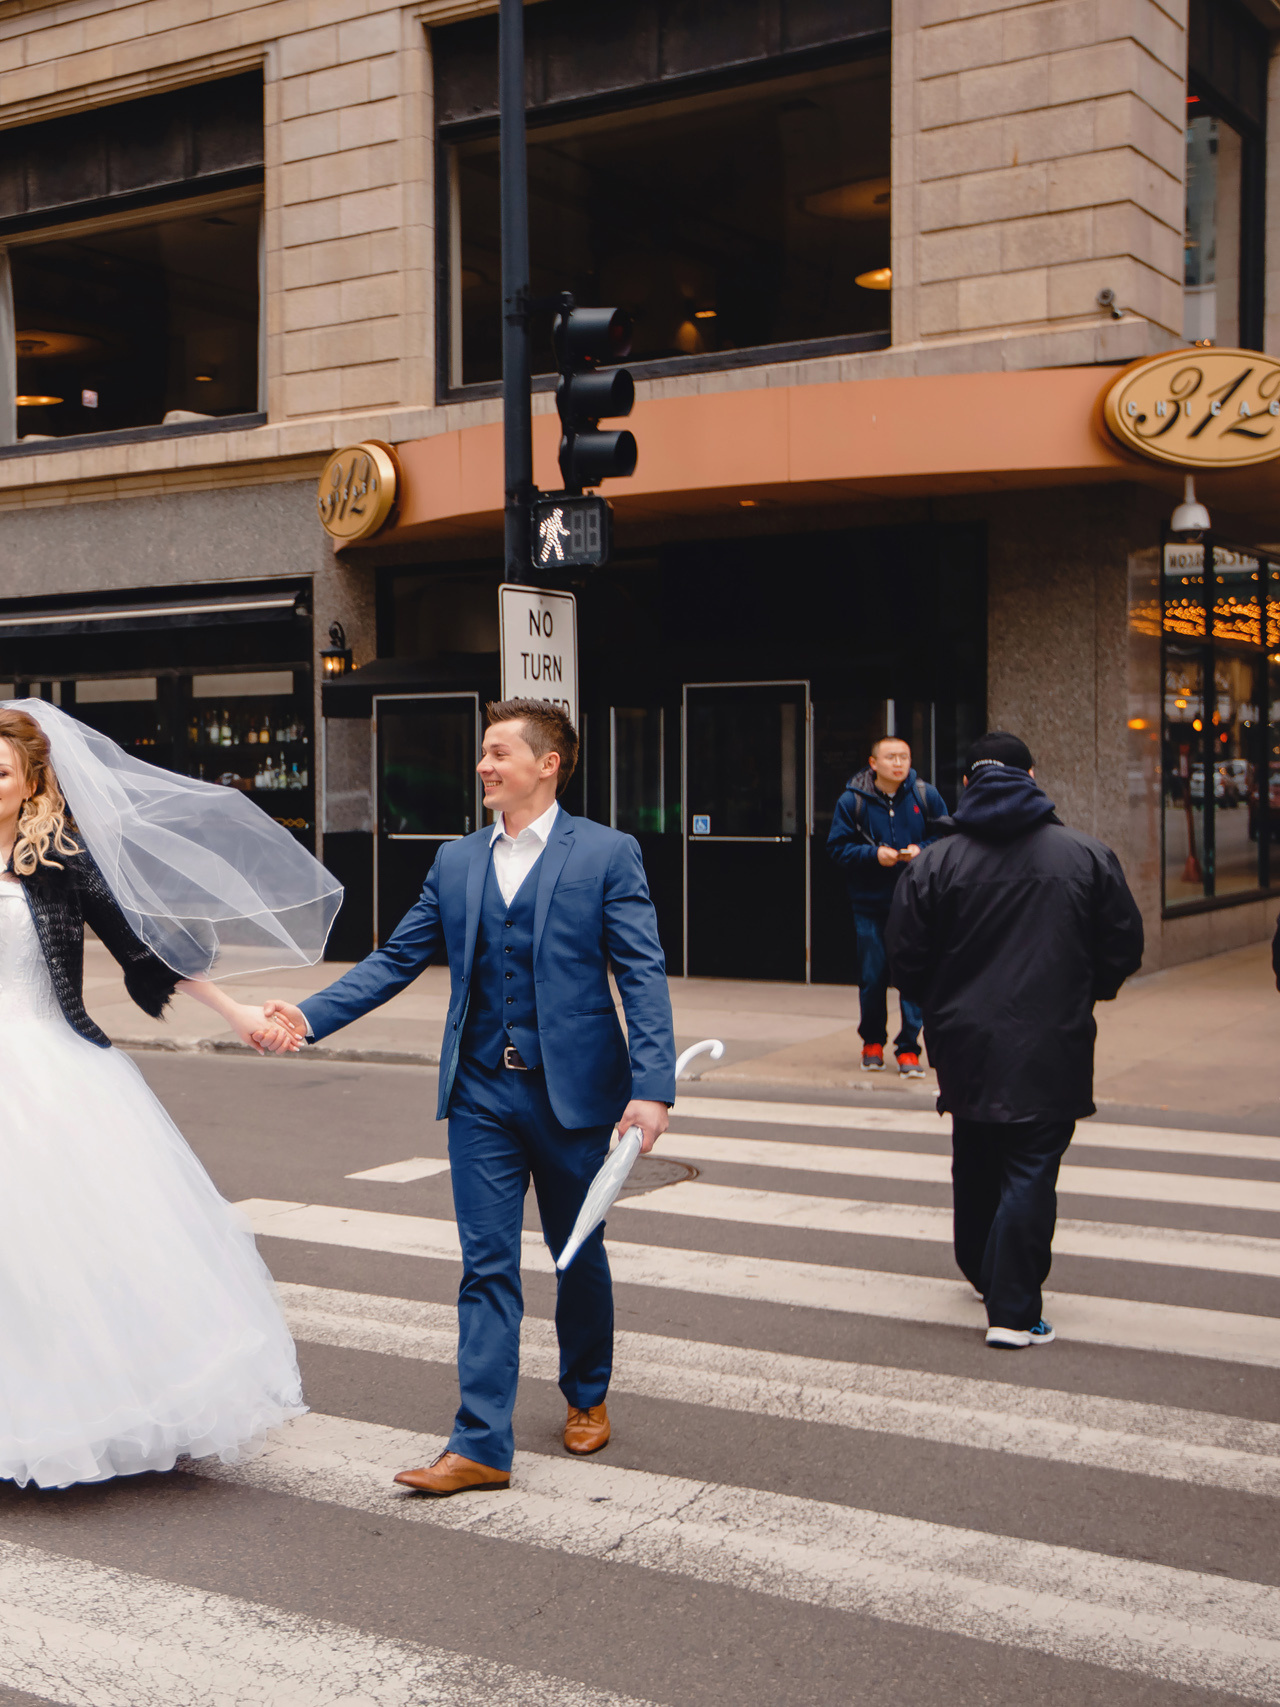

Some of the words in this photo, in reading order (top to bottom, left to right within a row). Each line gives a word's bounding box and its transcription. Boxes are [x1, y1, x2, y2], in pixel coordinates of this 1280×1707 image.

[1127, 400, 1280, 417] CHICAG
[1133, 366, 1280, 440] 312
[320, 455, 372, 525] 312
[528, 608, 554, 638] NO
[520, 652, 563, 682] TURN
